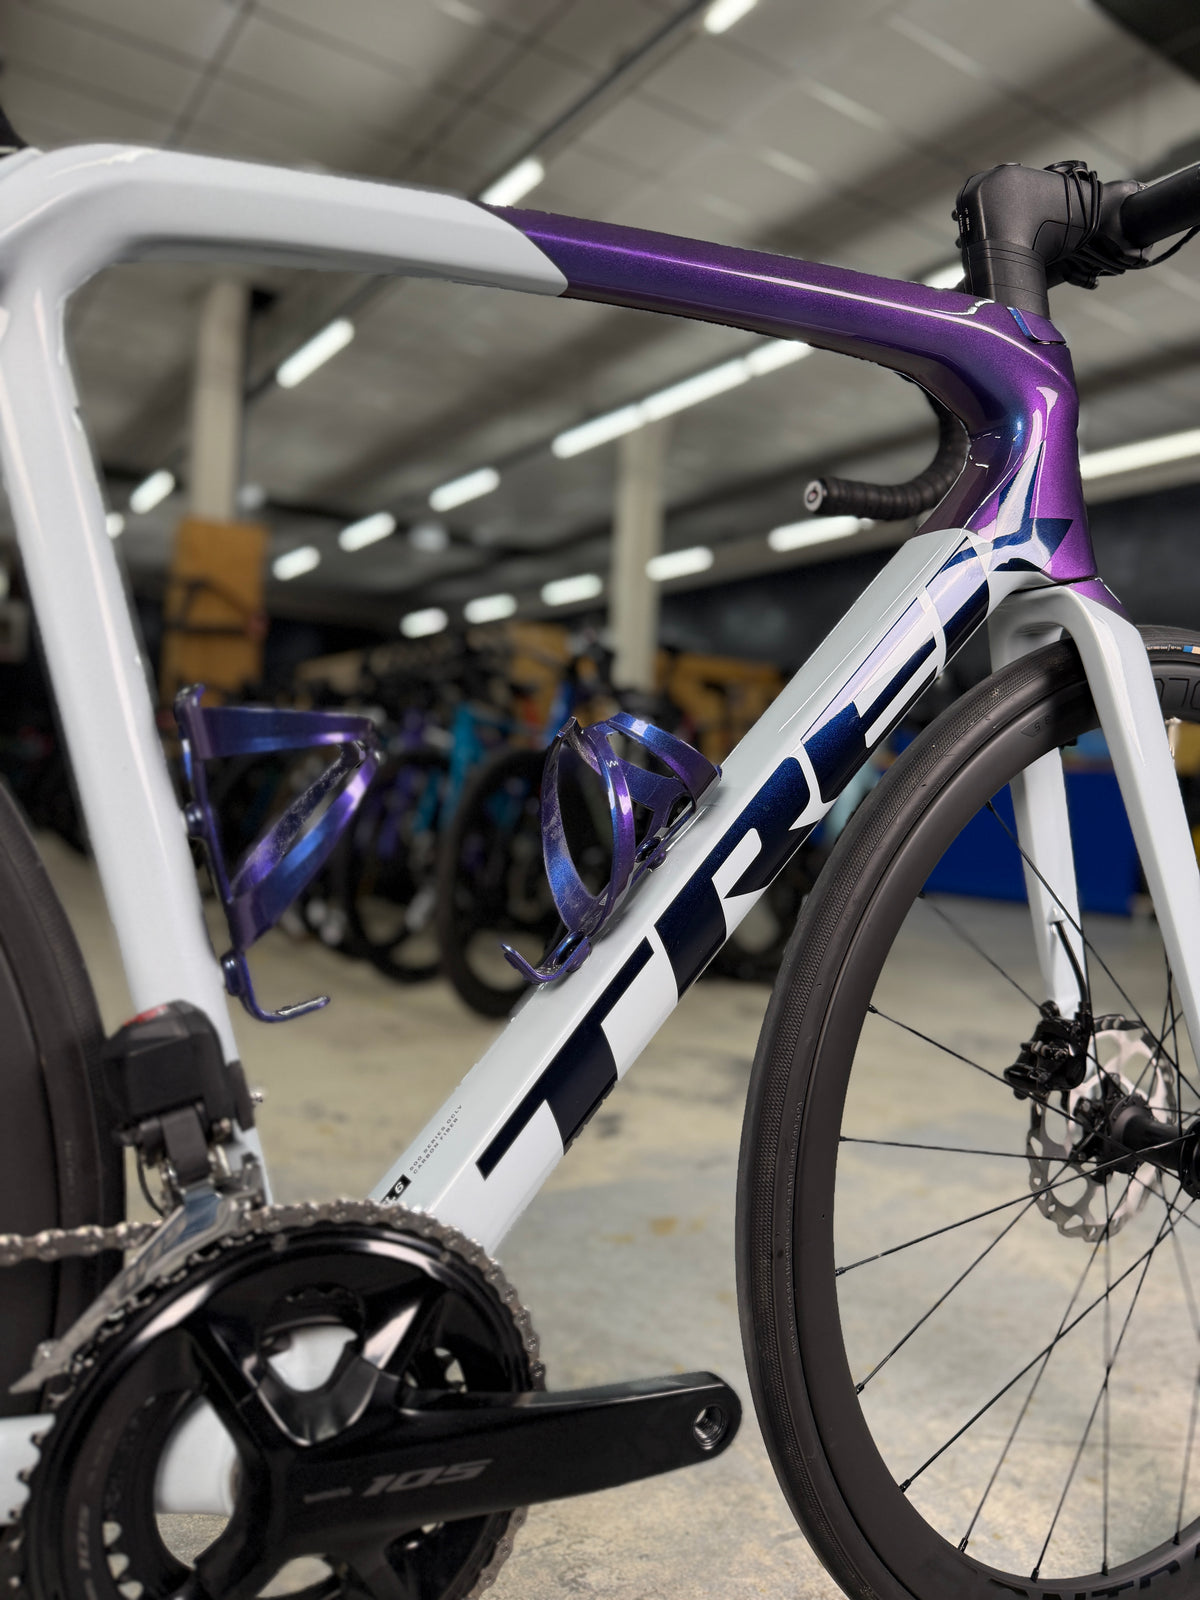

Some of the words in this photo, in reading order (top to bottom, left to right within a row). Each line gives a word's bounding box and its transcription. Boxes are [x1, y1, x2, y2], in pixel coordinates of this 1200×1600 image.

[476, 440, 1075, 1181] TREK
[413, 1142, 439, 1174] CARBON
[440, 1117, 458, 1140] FIBER
[423, 1126, 446, 1154] SERIES
[446, 1105, 462, 1124] OCLV
[394, 1181, 405, 1194] 6
[363, 1459, 493, 1496] 105
